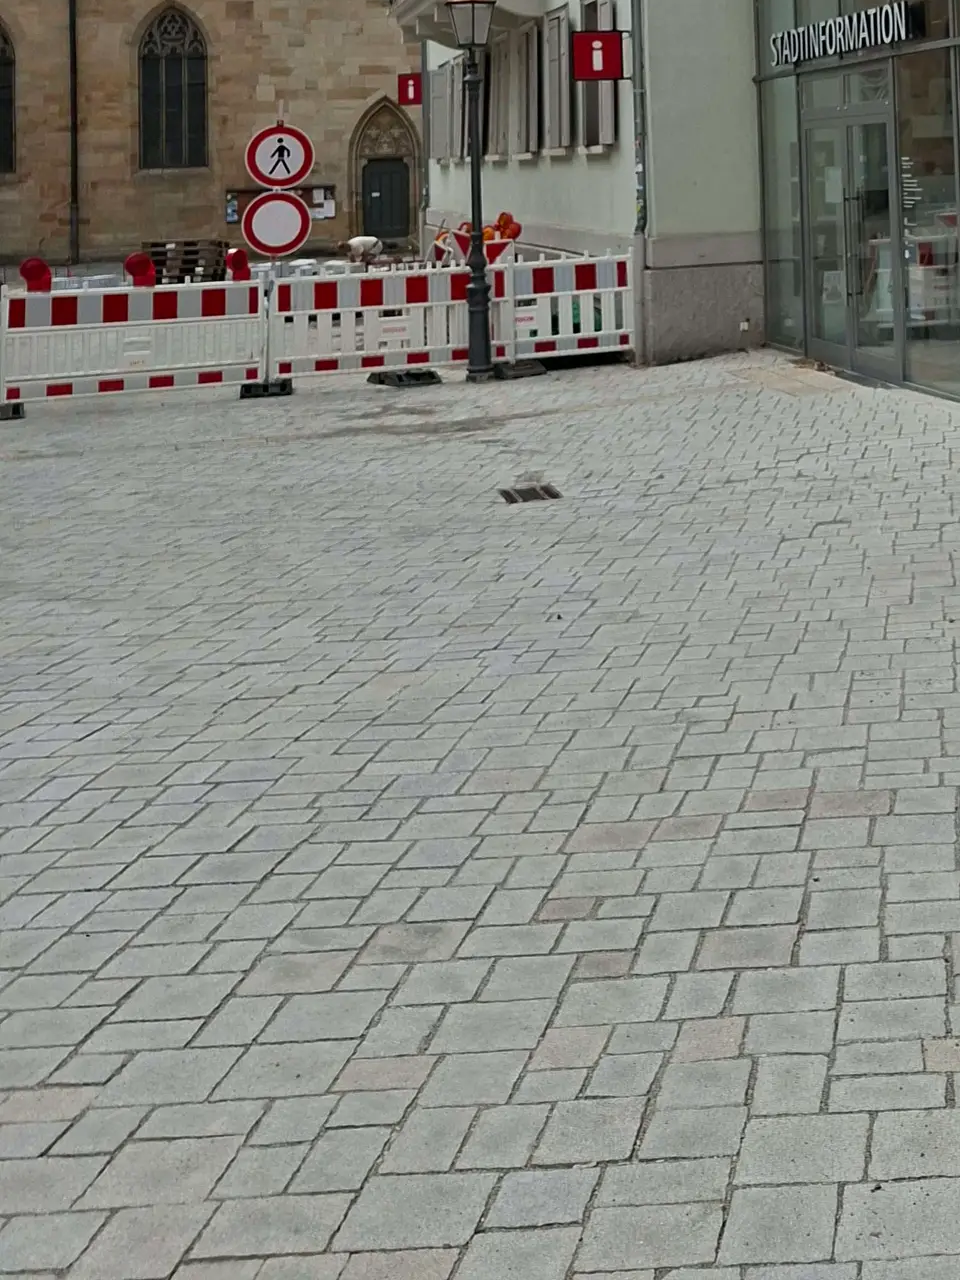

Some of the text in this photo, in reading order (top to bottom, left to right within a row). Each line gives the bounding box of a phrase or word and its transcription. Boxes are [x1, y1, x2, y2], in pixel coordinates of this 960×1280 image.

[770, 0, 906, 67] STADTINFORMATION
[591, 40, 604, 71] i
[407, 79, 415, 100] i
